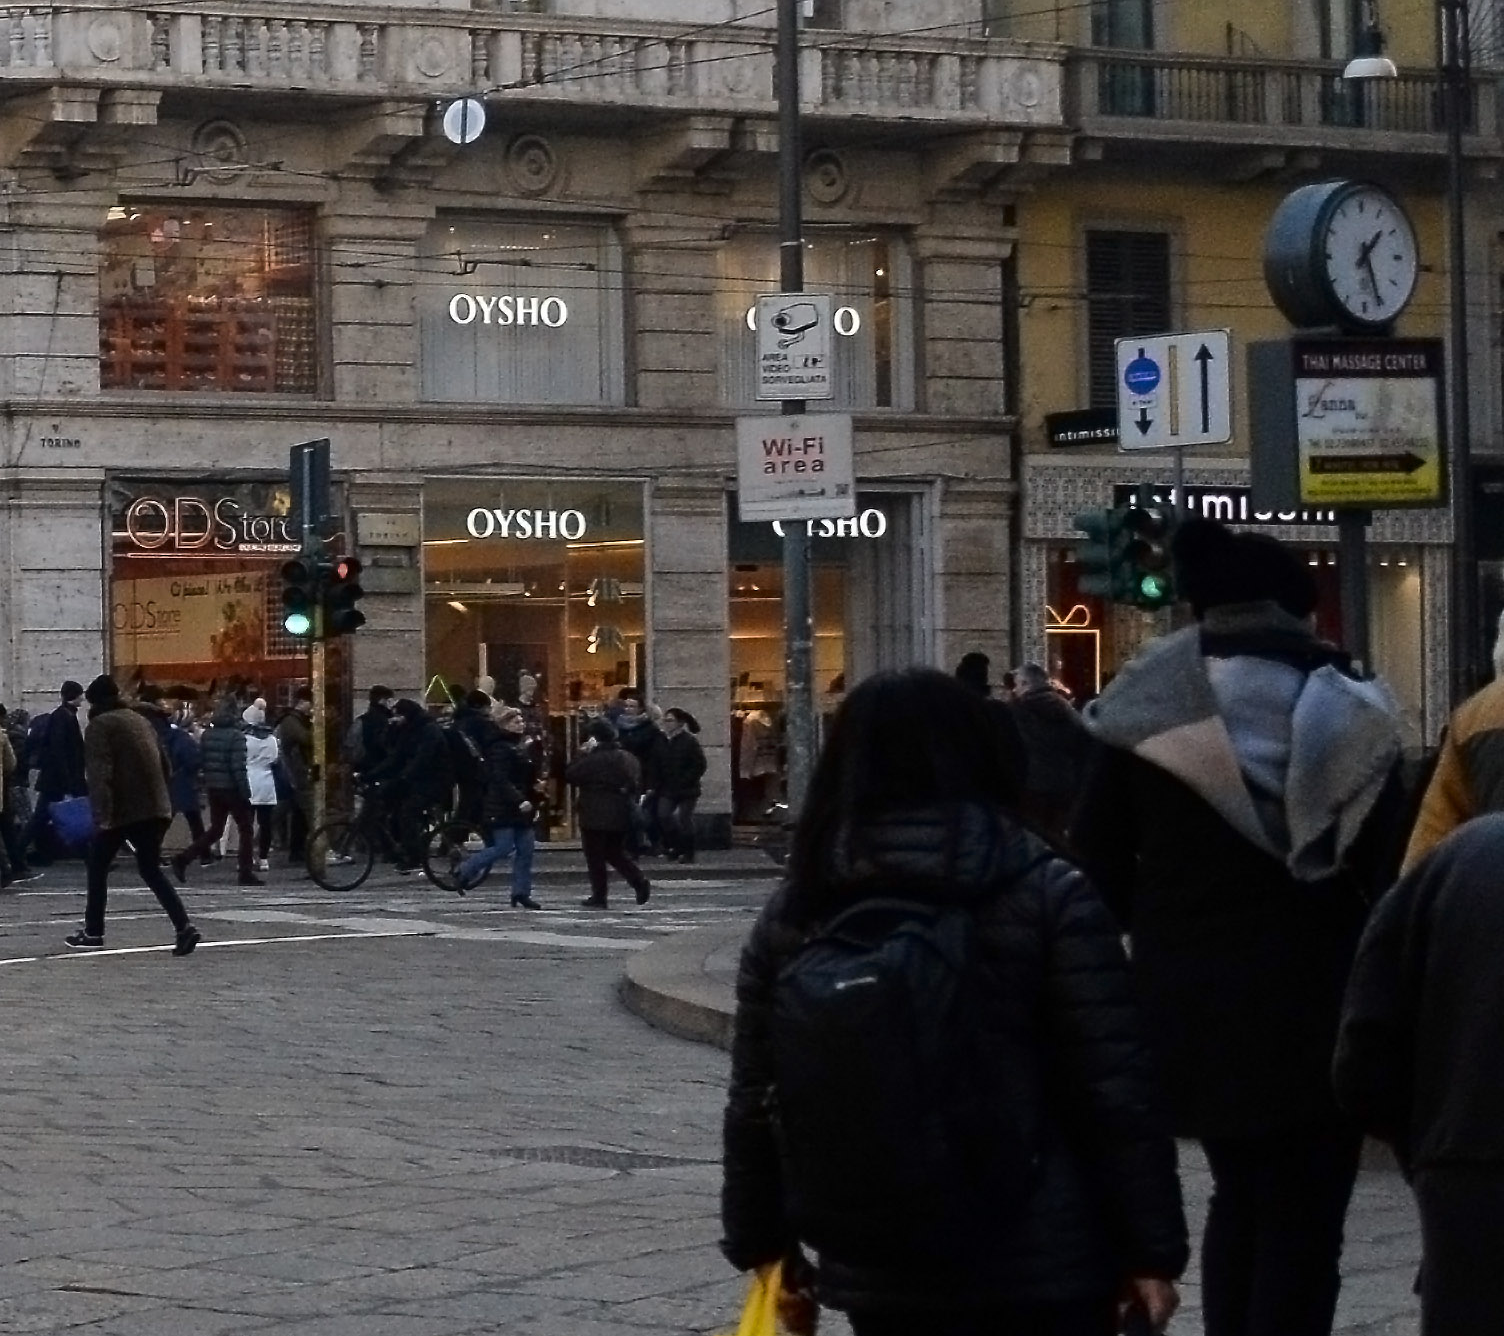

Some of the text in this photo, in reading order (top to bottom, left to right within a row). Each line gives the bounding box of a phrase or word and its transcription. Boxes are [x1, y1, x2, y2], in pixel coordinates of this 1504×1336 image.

[449, 294, 568, 327] OYSHO
[762, 353, 788, 361] AREA
[1302, 354, 1426, 369] THAI MASSAGE CENTER
[762, 365, 791, 373] VIDEO
[762, 375, 827, 384] SORVEGLIATA
[40, 438, 81, 448] TORINO
[763, 437, 824, 456] Wi-Fi
[764, 459, 824, 475] area
[467, 508, 586, 539] OYSHO
